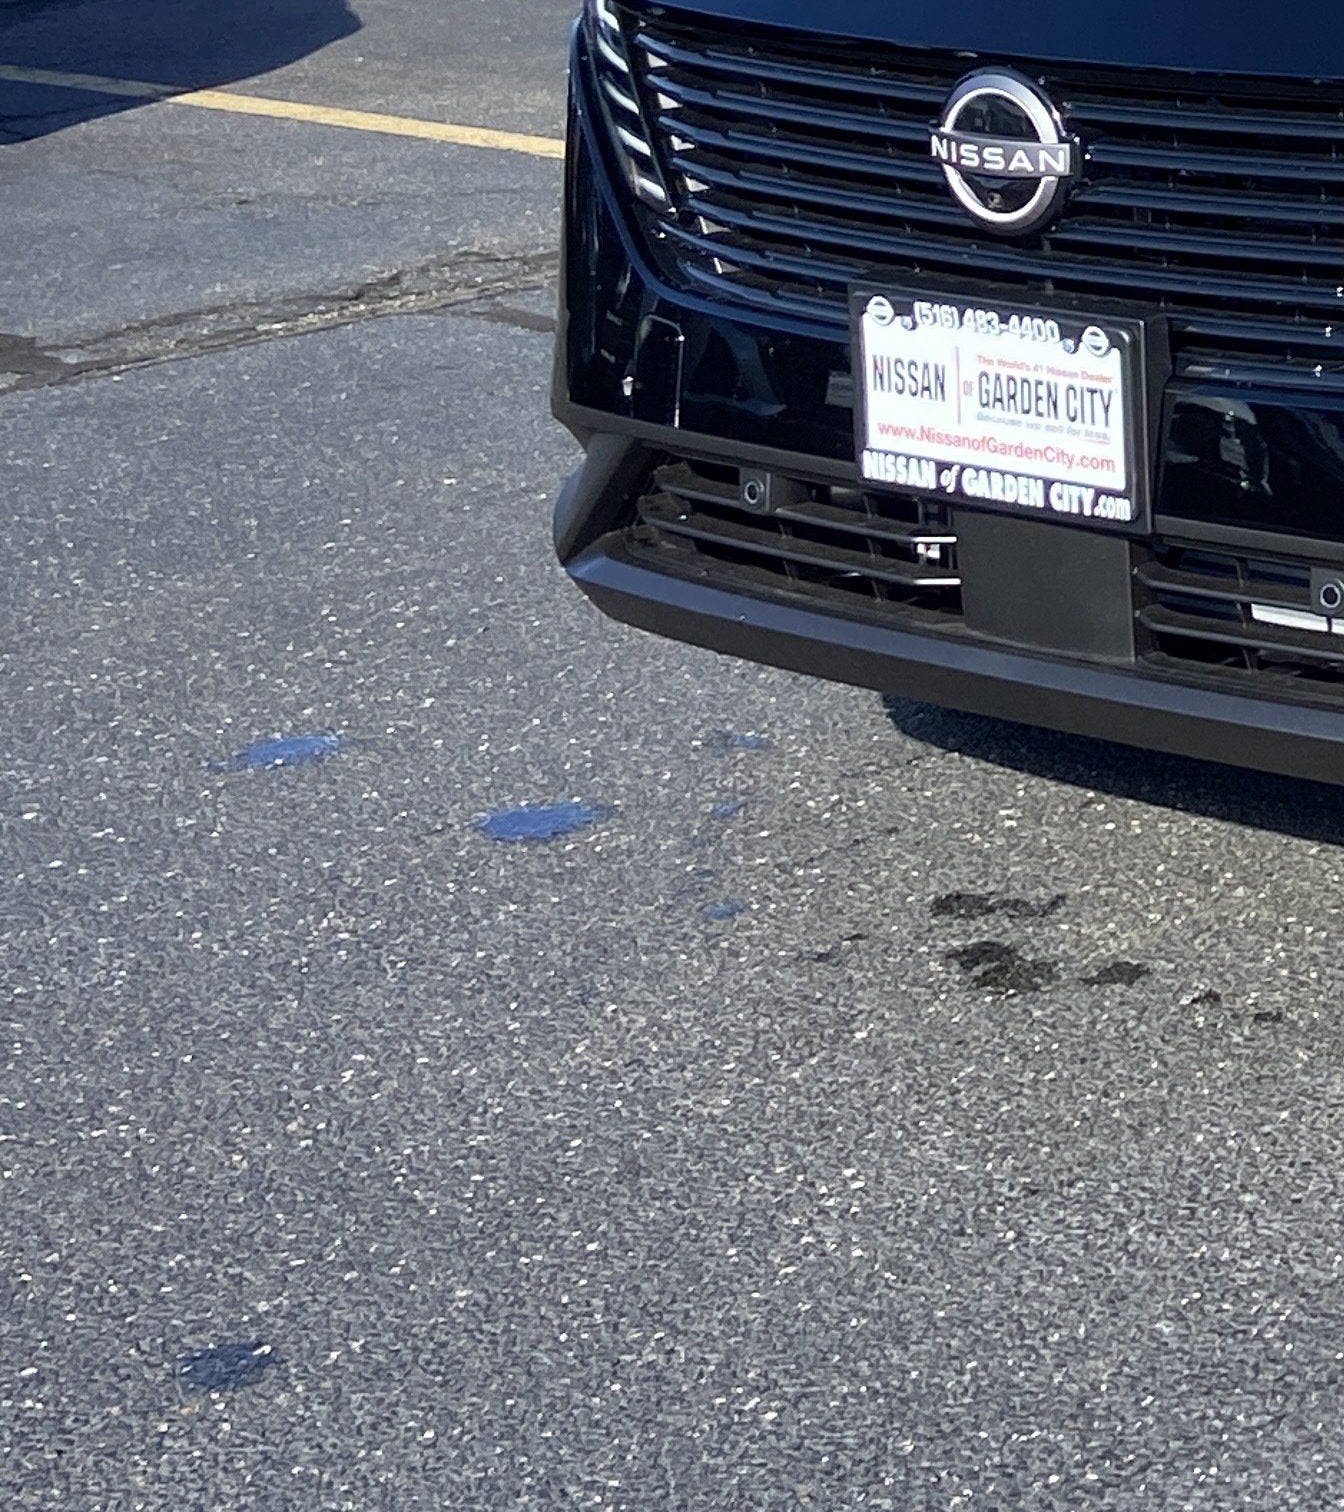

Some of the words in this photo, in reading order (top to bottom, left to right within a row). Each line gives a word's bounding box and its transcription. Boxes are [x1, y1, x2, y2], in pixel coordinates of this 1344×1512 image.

[931, 135, 1066, 172] NISSAN
[914, 300, 960, 329] (516)
[963, 308, 1060, 343] 483-4400
[872, 354, 946, 402] NISSAN
[963, 380, 974, 397] OF
[978, 370, 1059, 420] GARDEN
[1066, 384, 1113, 428] CITY
[977, 355, 994, 366] The
[997, 358, 1030, 372] World's
[1046, 366, 1079, 378] Nissan
[1081, 371, 1113, 384] Dealer
[877, 422, 1116, 473] www.NissanofGardenCity.com
[862, 449, 936, 490] NISSAN
[940, 464, 961, 493] of
[961, 467, 1045, 508] GARDEN
